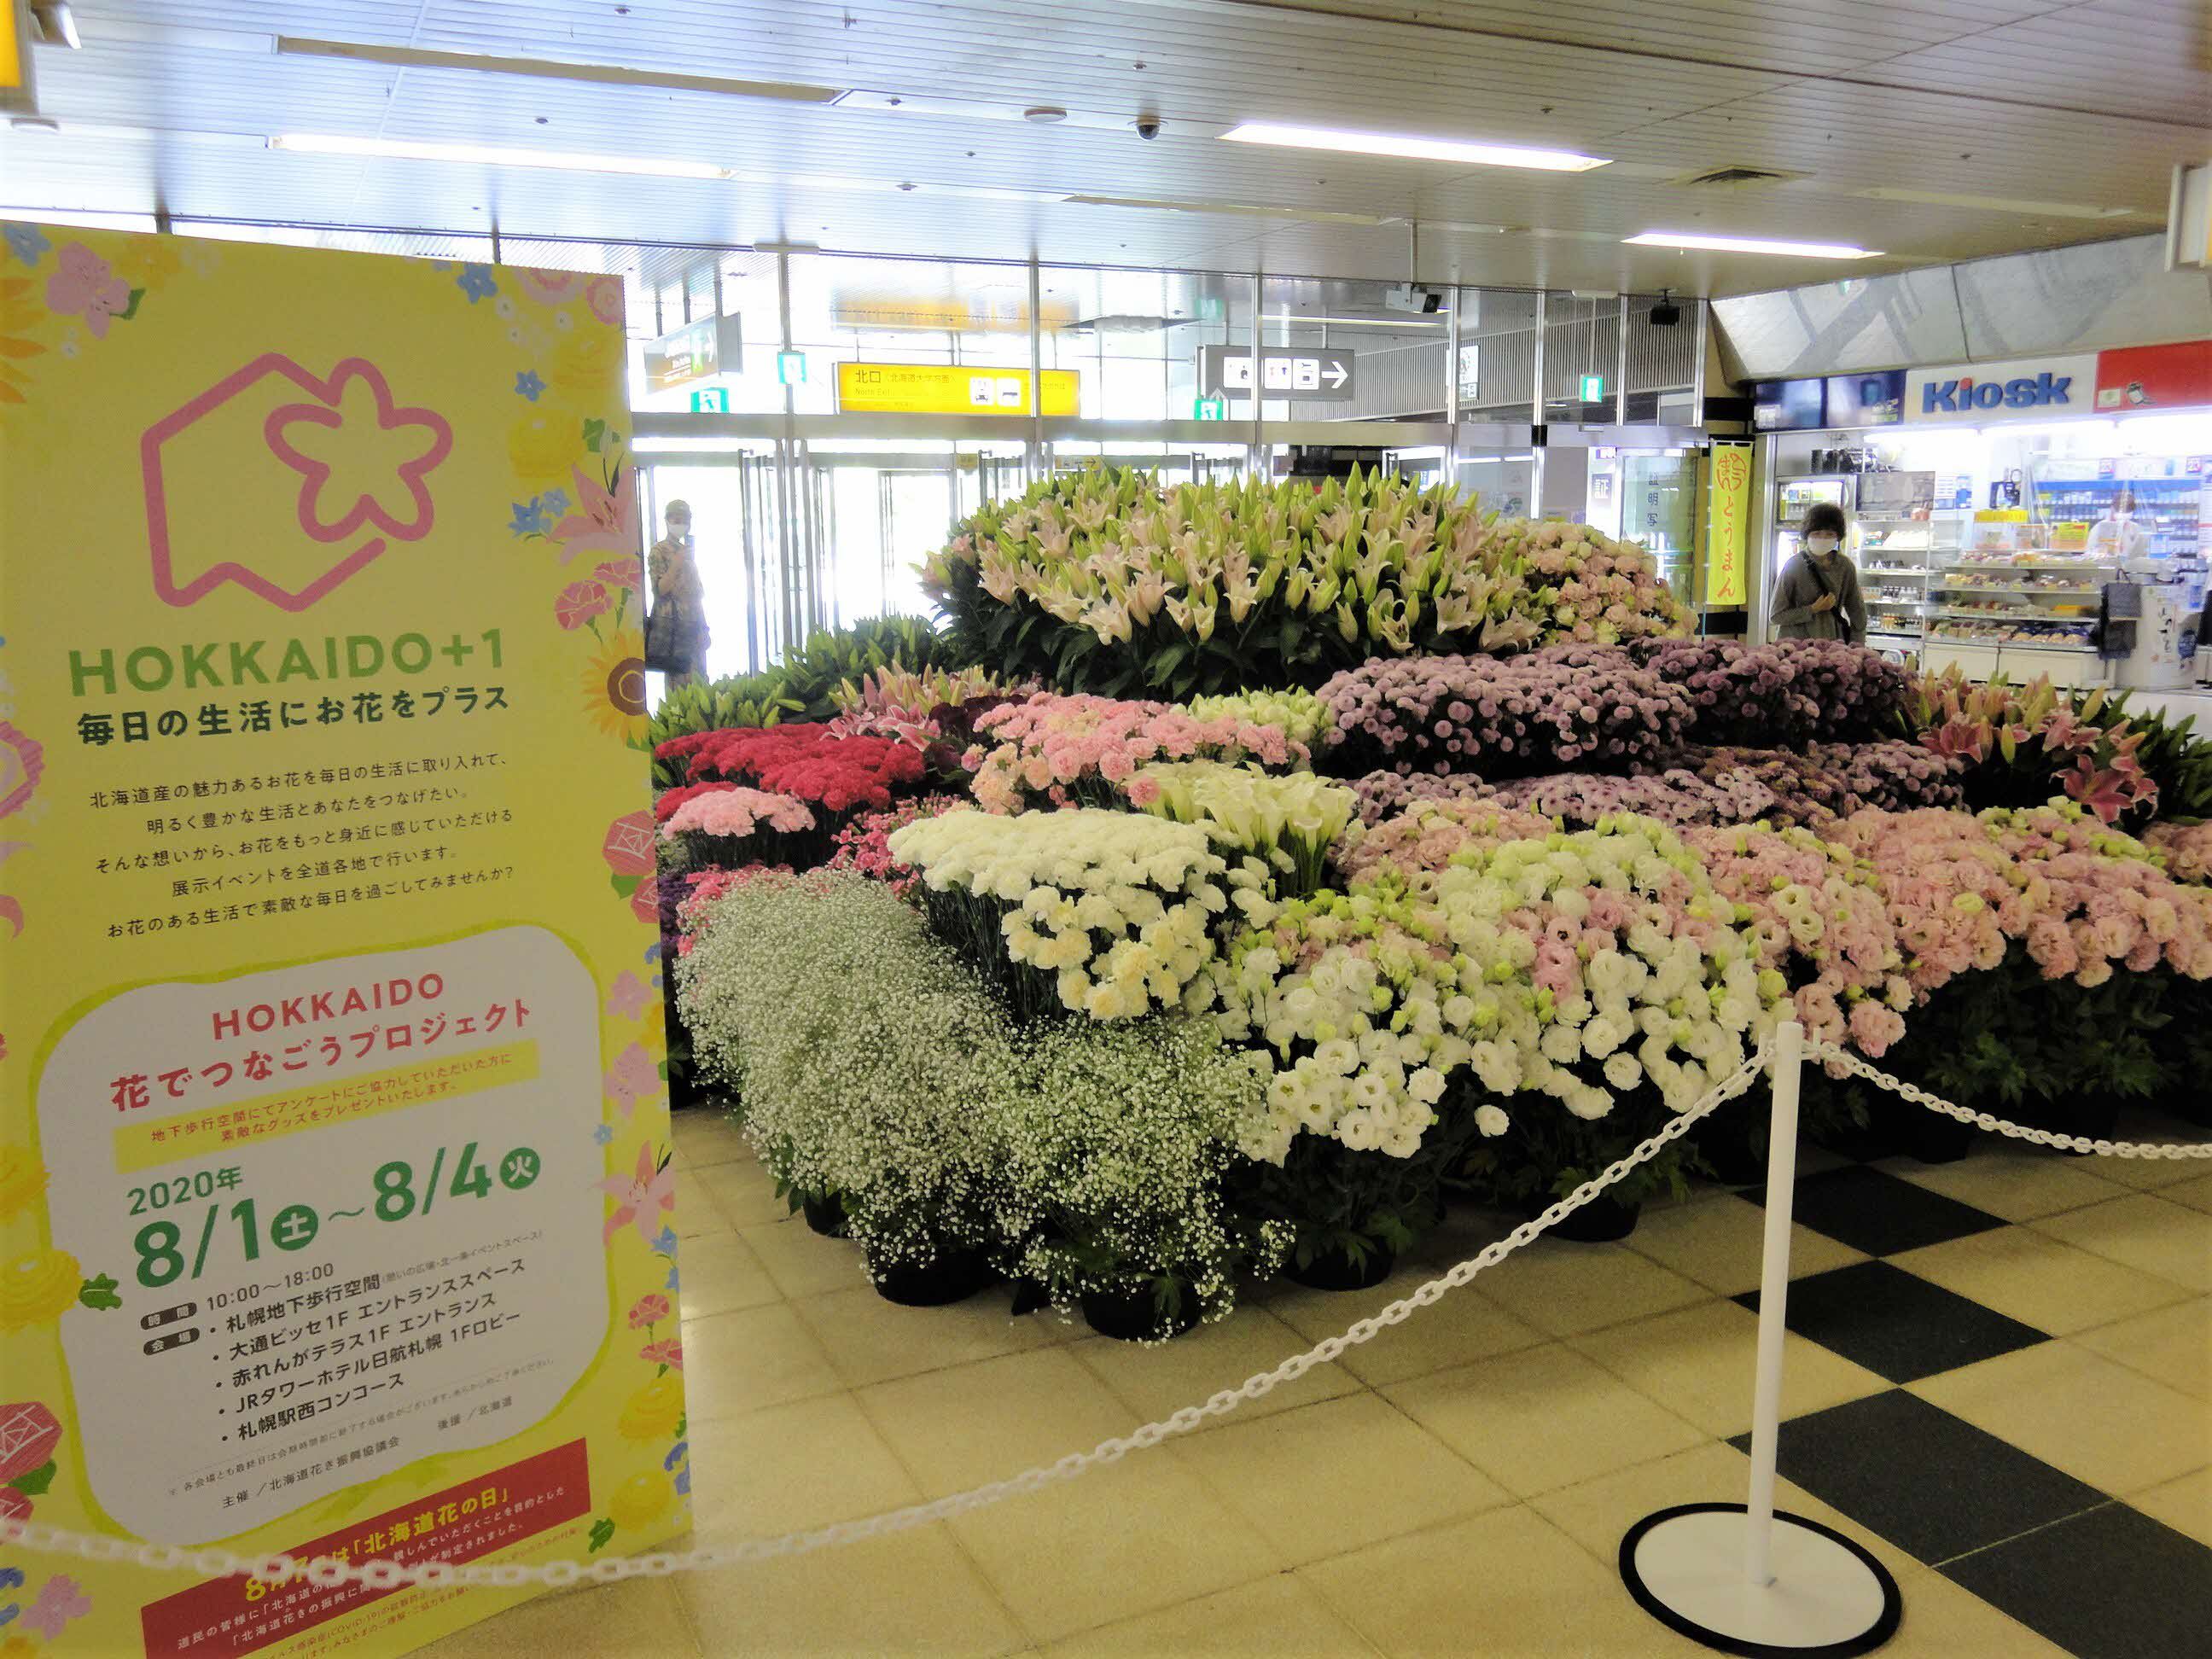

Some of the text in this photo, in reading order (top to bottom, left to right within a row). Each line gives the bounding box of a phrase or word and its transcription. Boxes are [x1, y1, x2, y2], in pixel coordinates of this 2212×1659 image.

[855, 369, 881, 383] 北口
[1922, 372, 2072, 413] Kiosk
[68, 628, 504, 696] HOKKAIDO+1
[77, 687, 509, 746] 毎日の生活にお花をプラス
[90, 753, 508, 809] 北海道産の魅力あるお花を毎日の生活に取り入れて、
[146, 788, 469, 835] 明るく豊かな生活とあなたをつなげたい。
[95, 806, 514, 874] そんな想いから、お花をもっと身近に感じていただける
[172, 845, 458, 898] 展示イベントを全道各地で行います。
[212, 973, 445, 1040] HOKKAIDO
[109, 998, 533, 1113] 花でつなごうプロジェクト
[127, 1166, 243, 1216] 2020年
